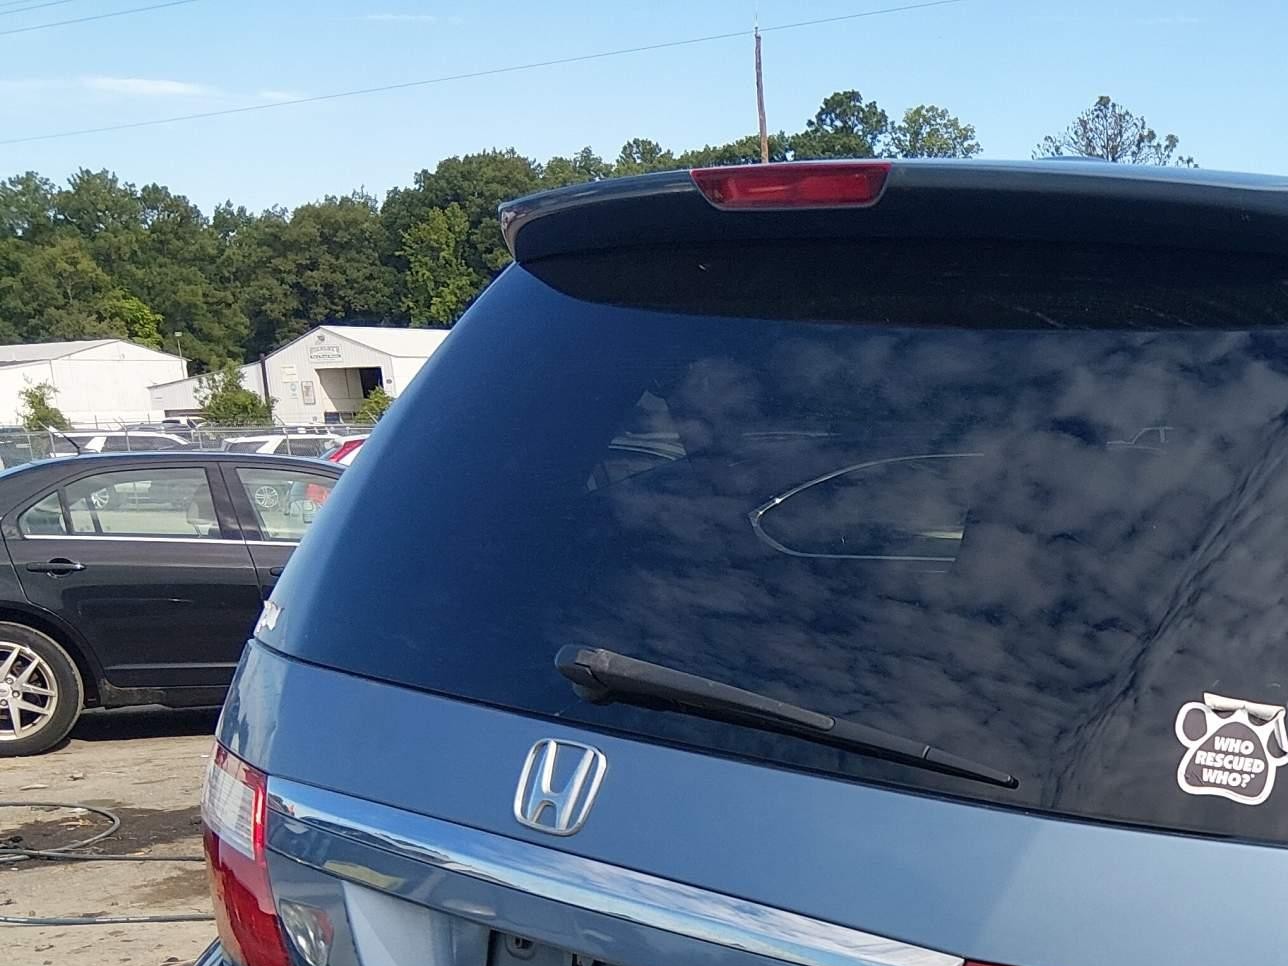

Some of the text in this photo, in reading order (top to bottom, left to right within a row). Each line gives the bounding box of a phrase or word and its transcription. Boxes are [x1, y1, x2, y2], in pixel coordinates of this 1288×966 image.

[1214, 736, 1255, 755] WHO
[1194, 750, 1265, 774] RESCUED
[1202, 768, 1251, 788] WHO?
